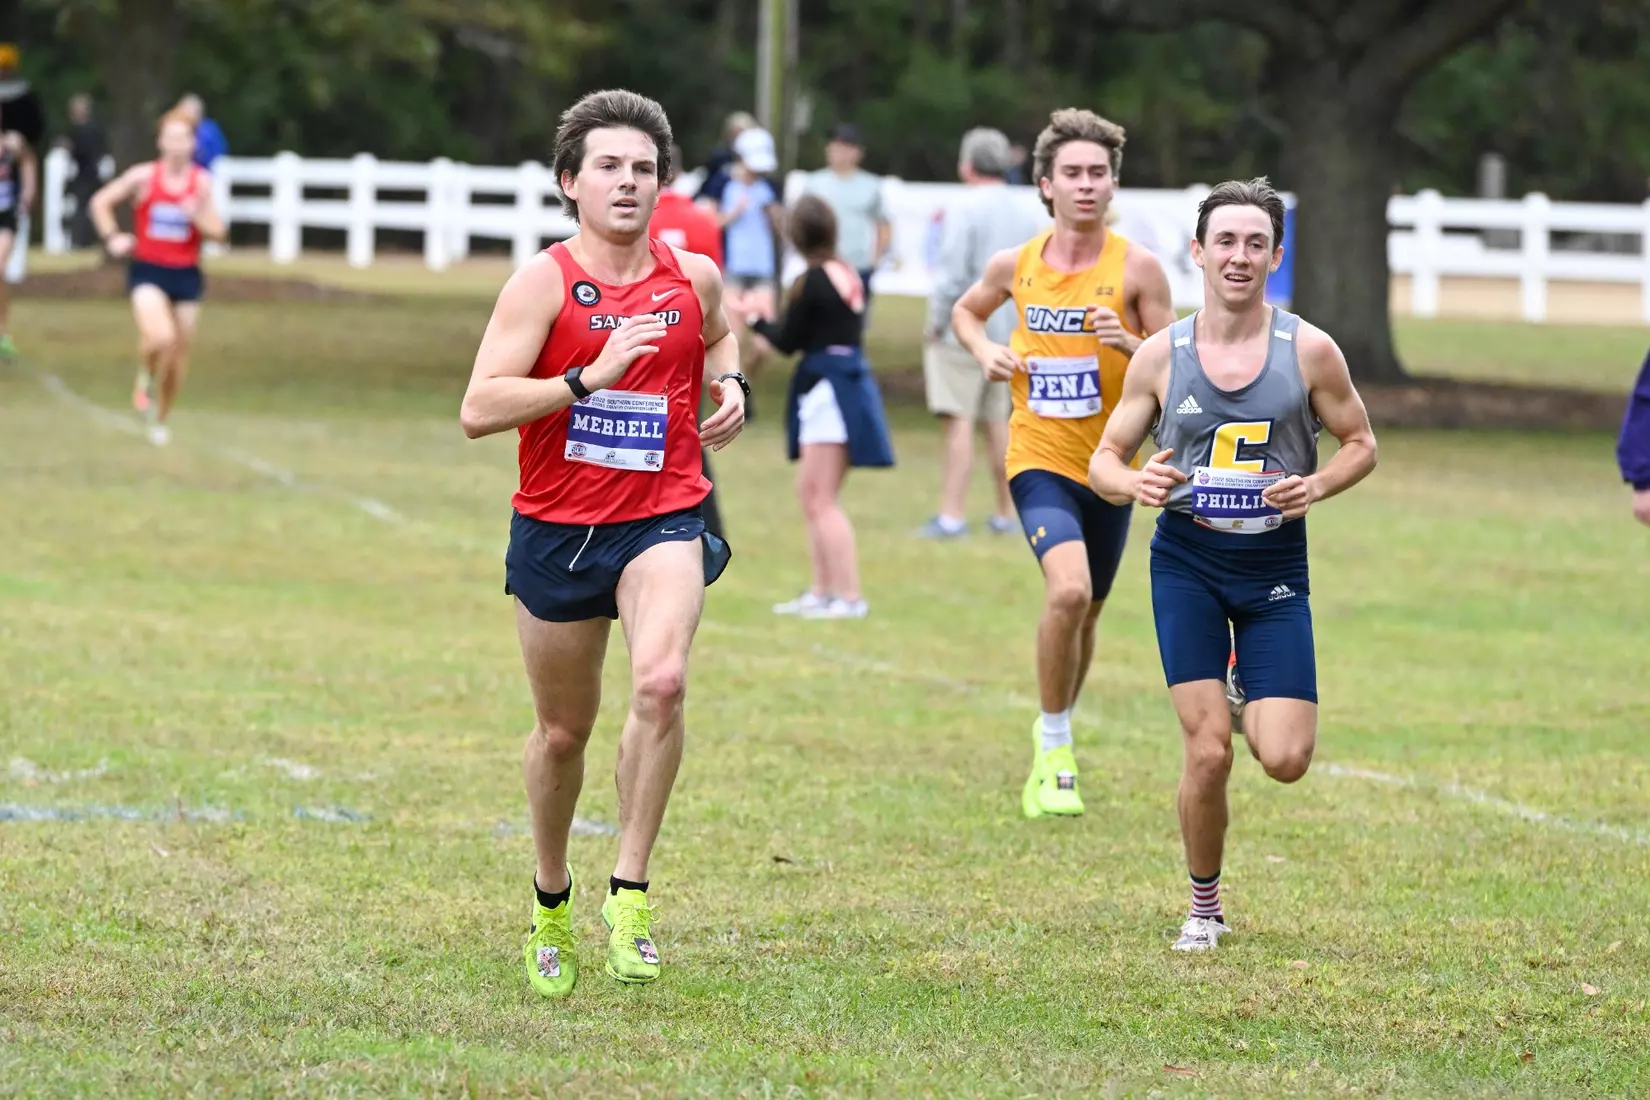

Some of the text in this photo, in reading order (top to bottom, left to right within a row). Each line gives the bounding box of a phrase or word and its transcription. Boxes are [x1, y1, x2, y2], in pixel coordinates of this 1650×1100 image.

[1030, 373, 1099, 399] PENA
[607, 398, 631, 406] SOUTHERN
[632, 400, 664, 408] CONFERENCE
[573, 413, 663, 439] MERRELL
